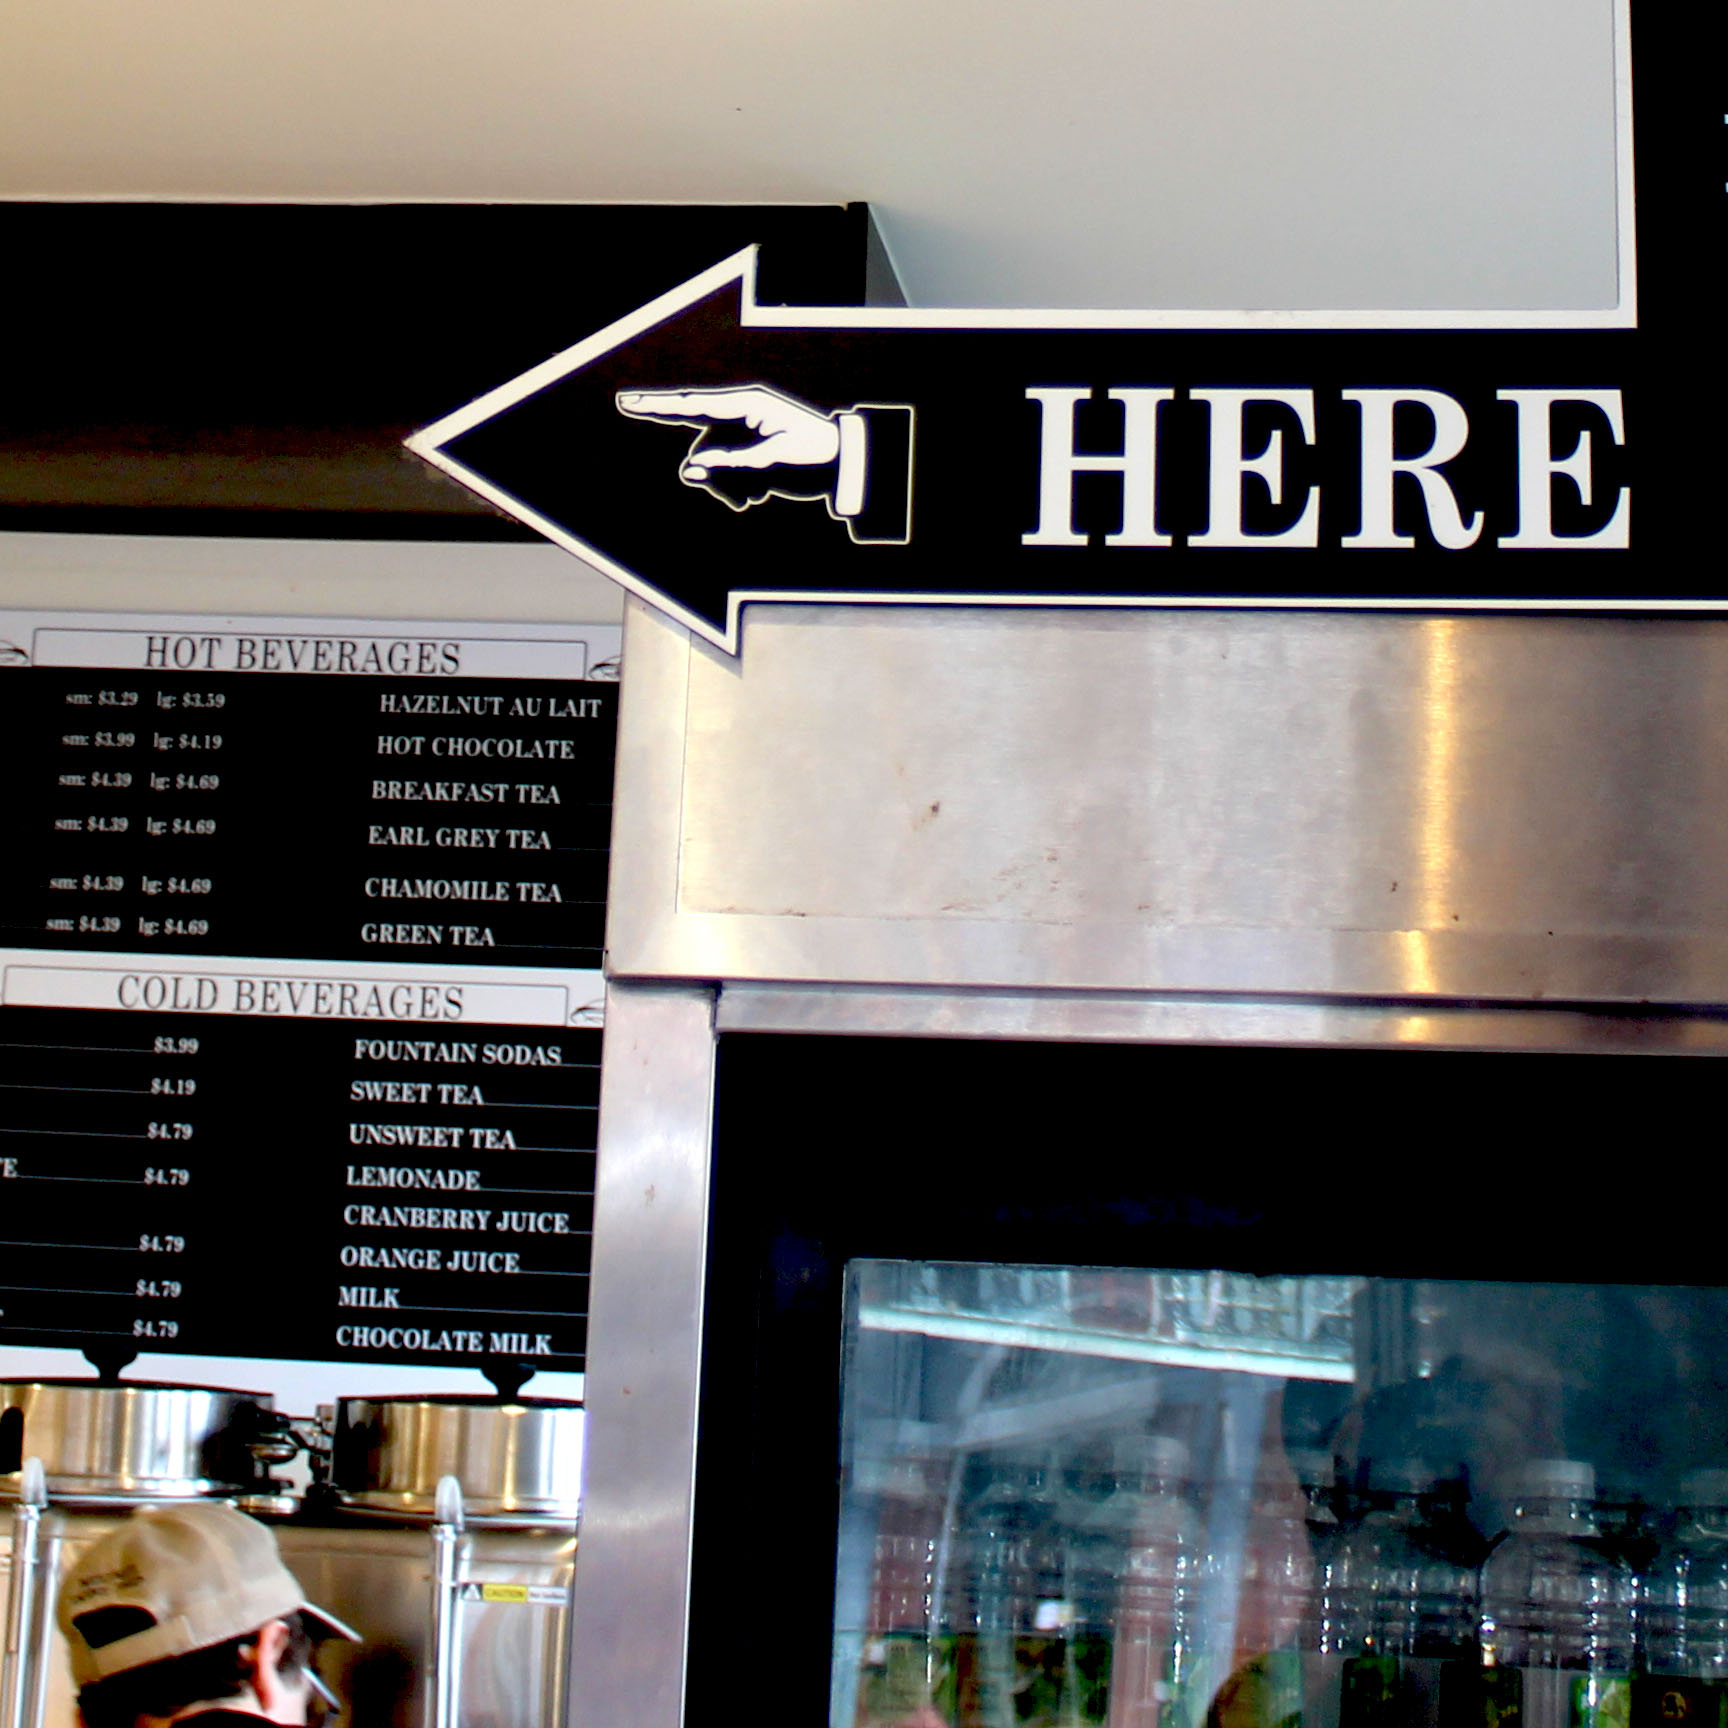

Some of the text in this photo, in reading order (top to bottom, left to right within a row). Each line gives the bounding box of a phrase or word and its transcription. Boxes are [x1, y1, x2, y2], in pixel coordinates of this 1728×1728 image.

[1021, 386, 1632, 550] HERE
[146, 635, 460, 674] HOT BEVERAGES
[380, 694, 601, 718] HAZELNUT AU LAIT
[377, 736, 575, 759] HOT CHOCOLATE
[372, 780, 561, 804] BREAKFAST TEA
[368, 825, 551, 850] EARL GREY TEA
[365, 877, 562, 903] CHAMOMILE TEA
[361, 923, 495, 947] GREEN TEA
[118, 976, 464, 1021] COLD BEVERAGES
[354, 1040, 562, 1066] FOUNTAIN SODAS
[150, 1078, 196, 1096] $4.19
[350, 1081, 485, 1106] SWEET TEA
[147, 1122, 193, 1140] $4.79
[349, 1124, 516, 1149] UNSWEET TEA
[144, 1167, 190, 1185] $4.79
[346, 1166, 481, 1191] LEMONADE
[344, 1204, 569, 1234] CRANBERRY JUICE
[139, 1234, 185, 1253] $4.79
[340, 1246, 520, 1273] ORANGE JUICE
[135, 1280, 182, 1299] $4.79
[339, 1286, 400, 1308] MILK
[132, 1320, 179, 1338] $4.79
[336, 1326, 552, 1355] CHOCOLATE MILK
